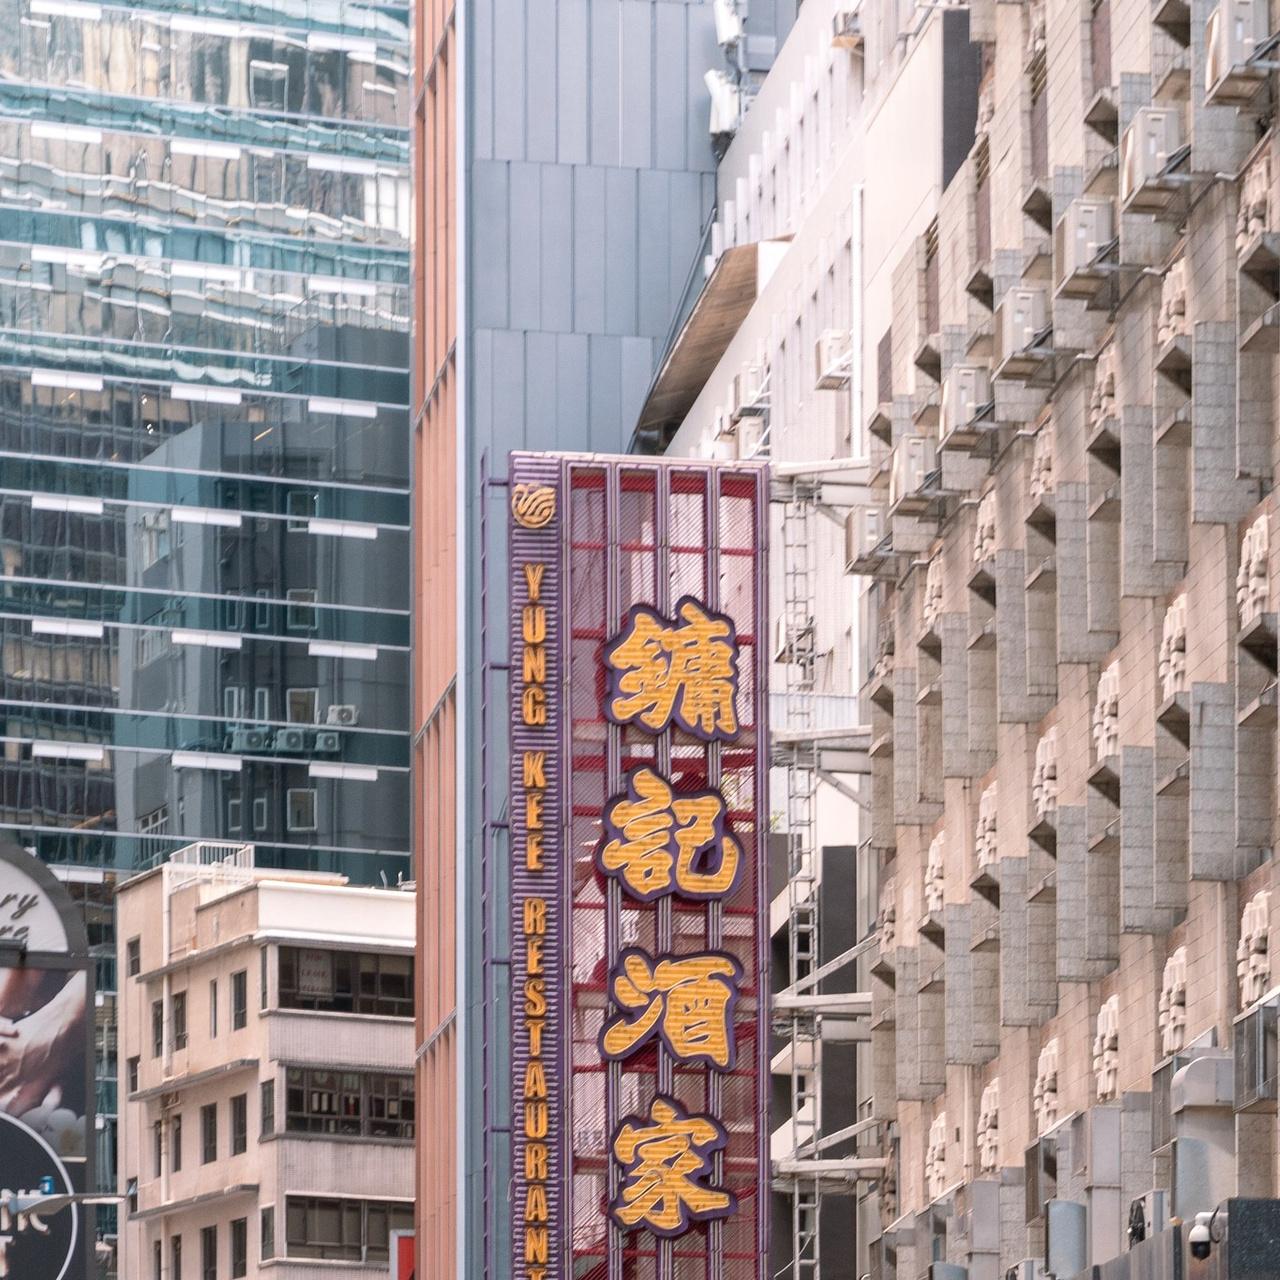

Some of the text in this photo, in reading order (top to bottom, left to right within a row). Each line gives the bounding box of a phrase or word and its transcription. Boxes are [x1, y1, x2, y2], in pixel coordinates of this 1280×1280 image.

[522, 563, 547, 726] YUNG
[522, 751, 546, 872] KEE
[602, 600, 740, 1231] 鏞記酒家
